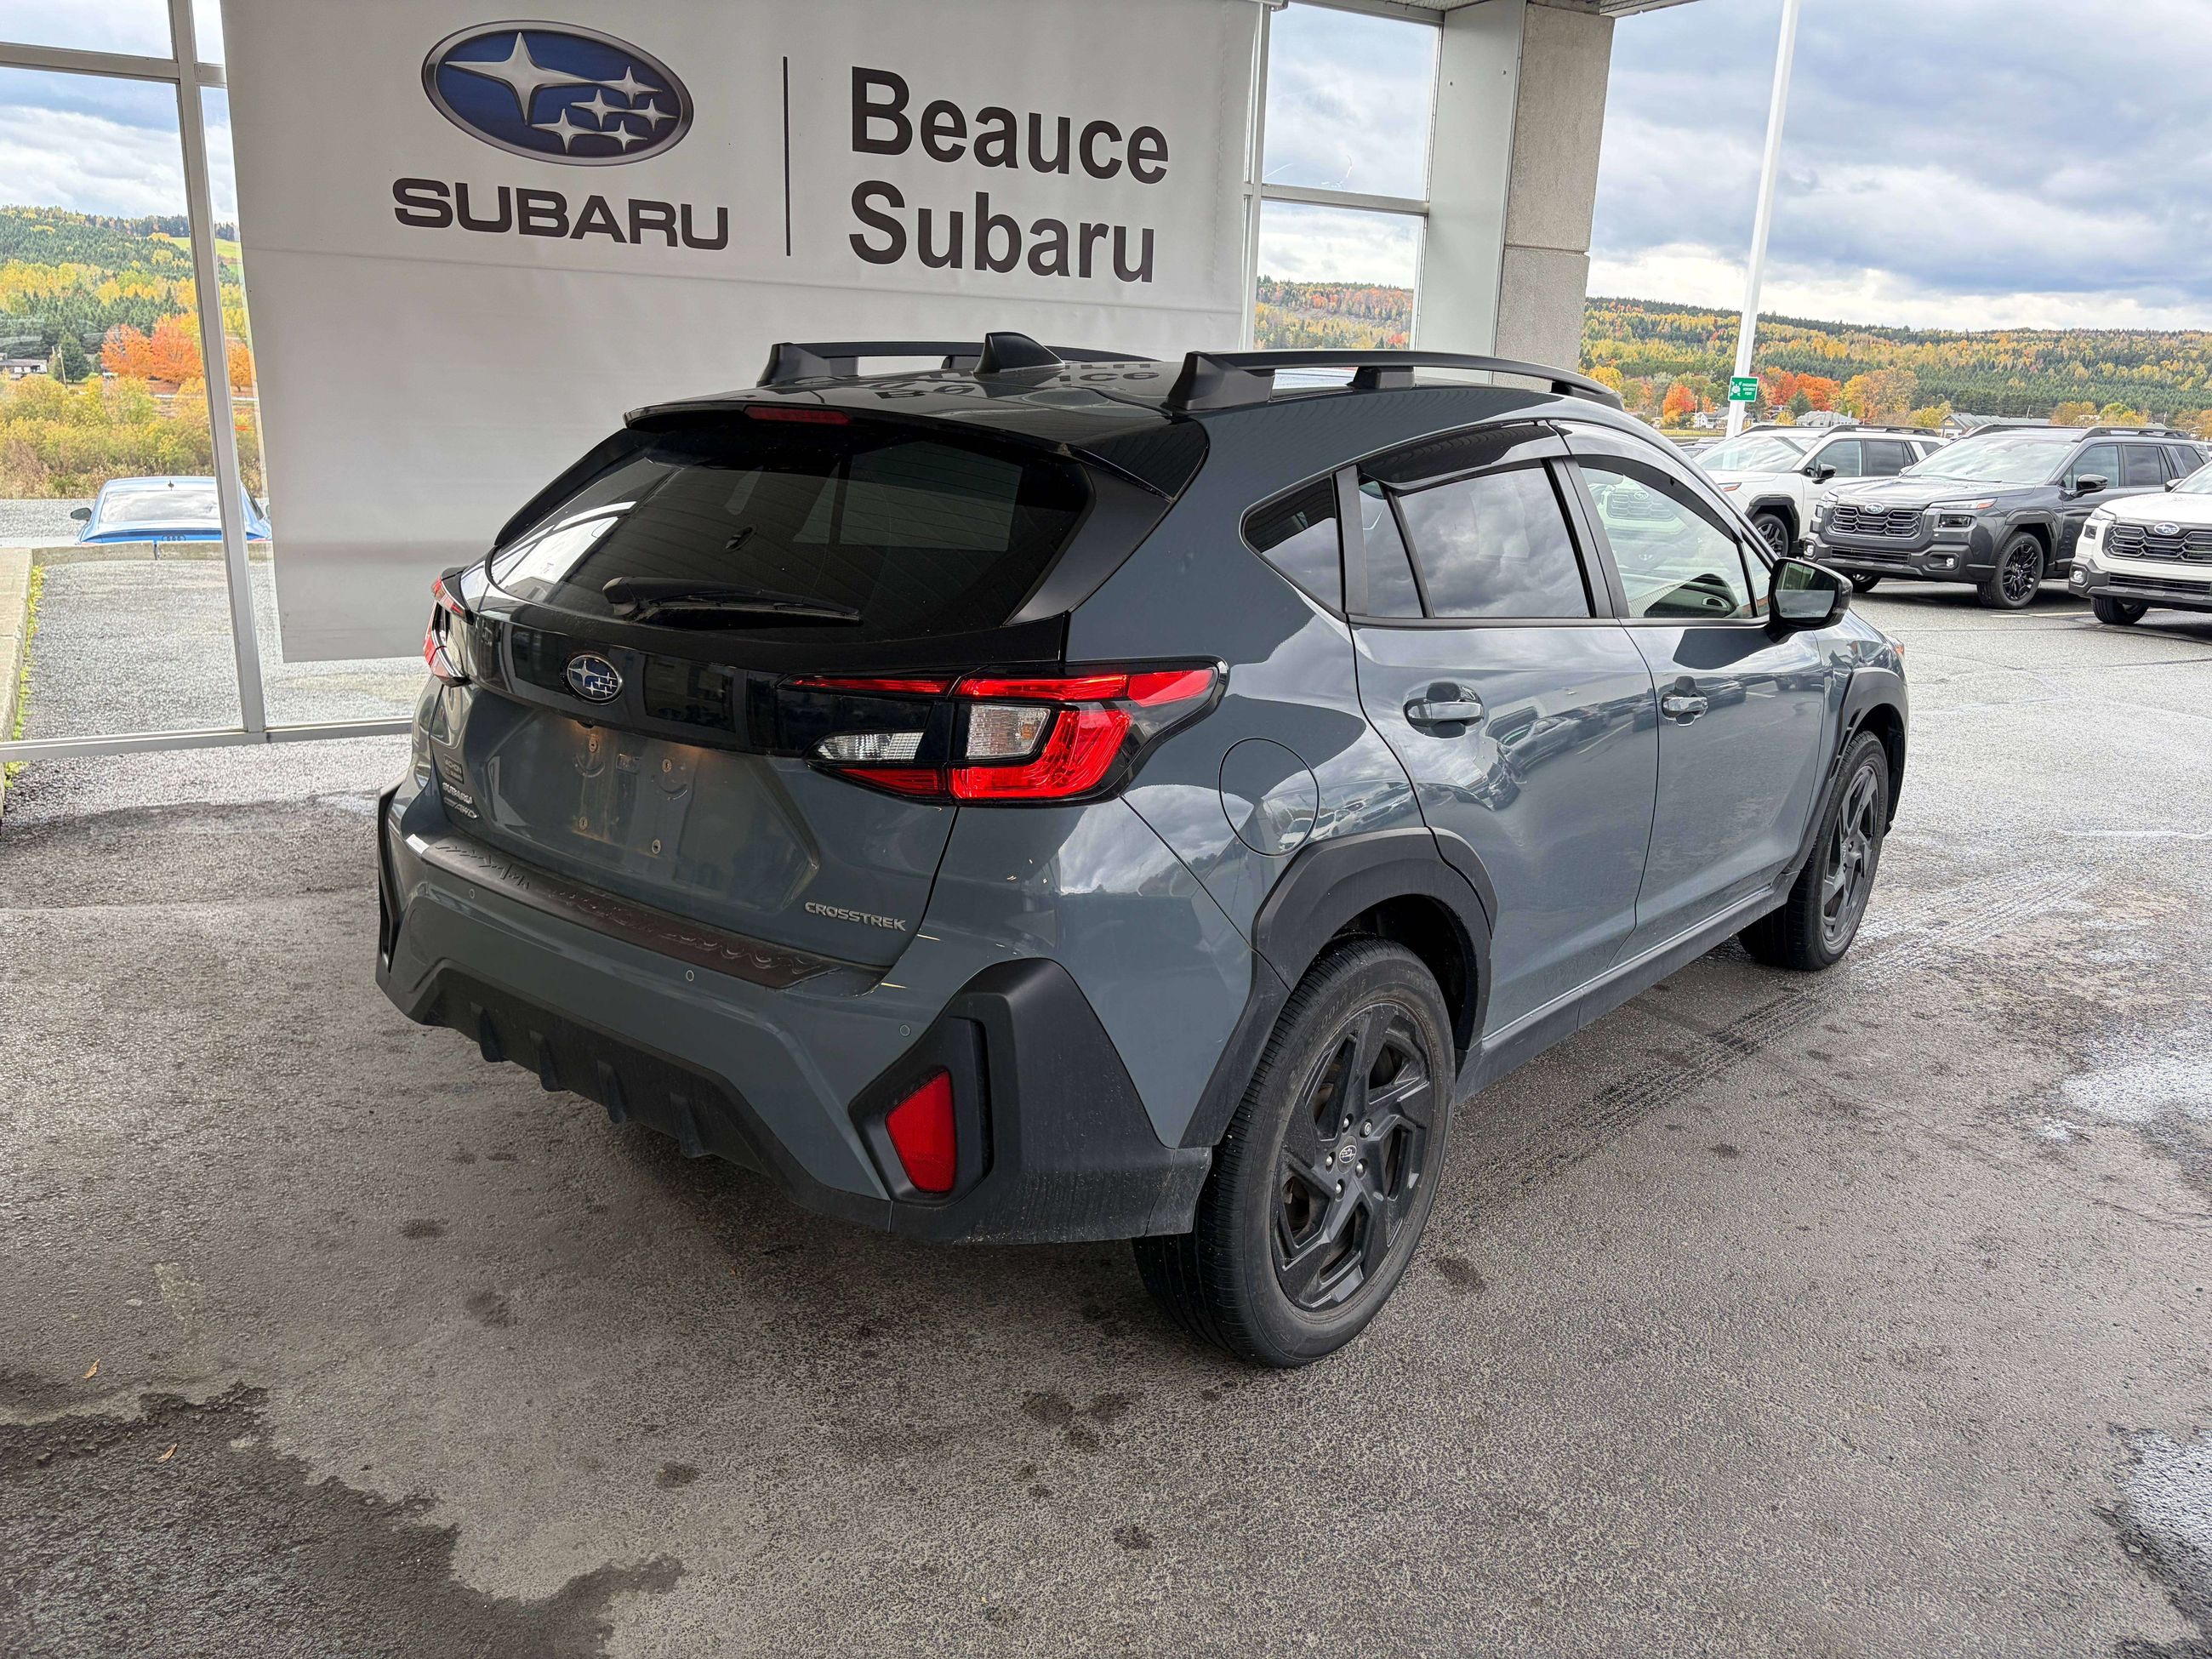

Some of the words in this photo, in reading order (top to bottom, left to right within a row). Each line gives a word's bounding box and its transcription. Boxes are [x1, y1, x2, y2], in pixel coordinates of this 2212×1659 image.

[852, 66, 1168, 184] Beauce
[393, 178, 727, 250] SUBARU
[849, 180, 1154, 282] Subaru
[805, 901, 906, 932] CROSSTREK
